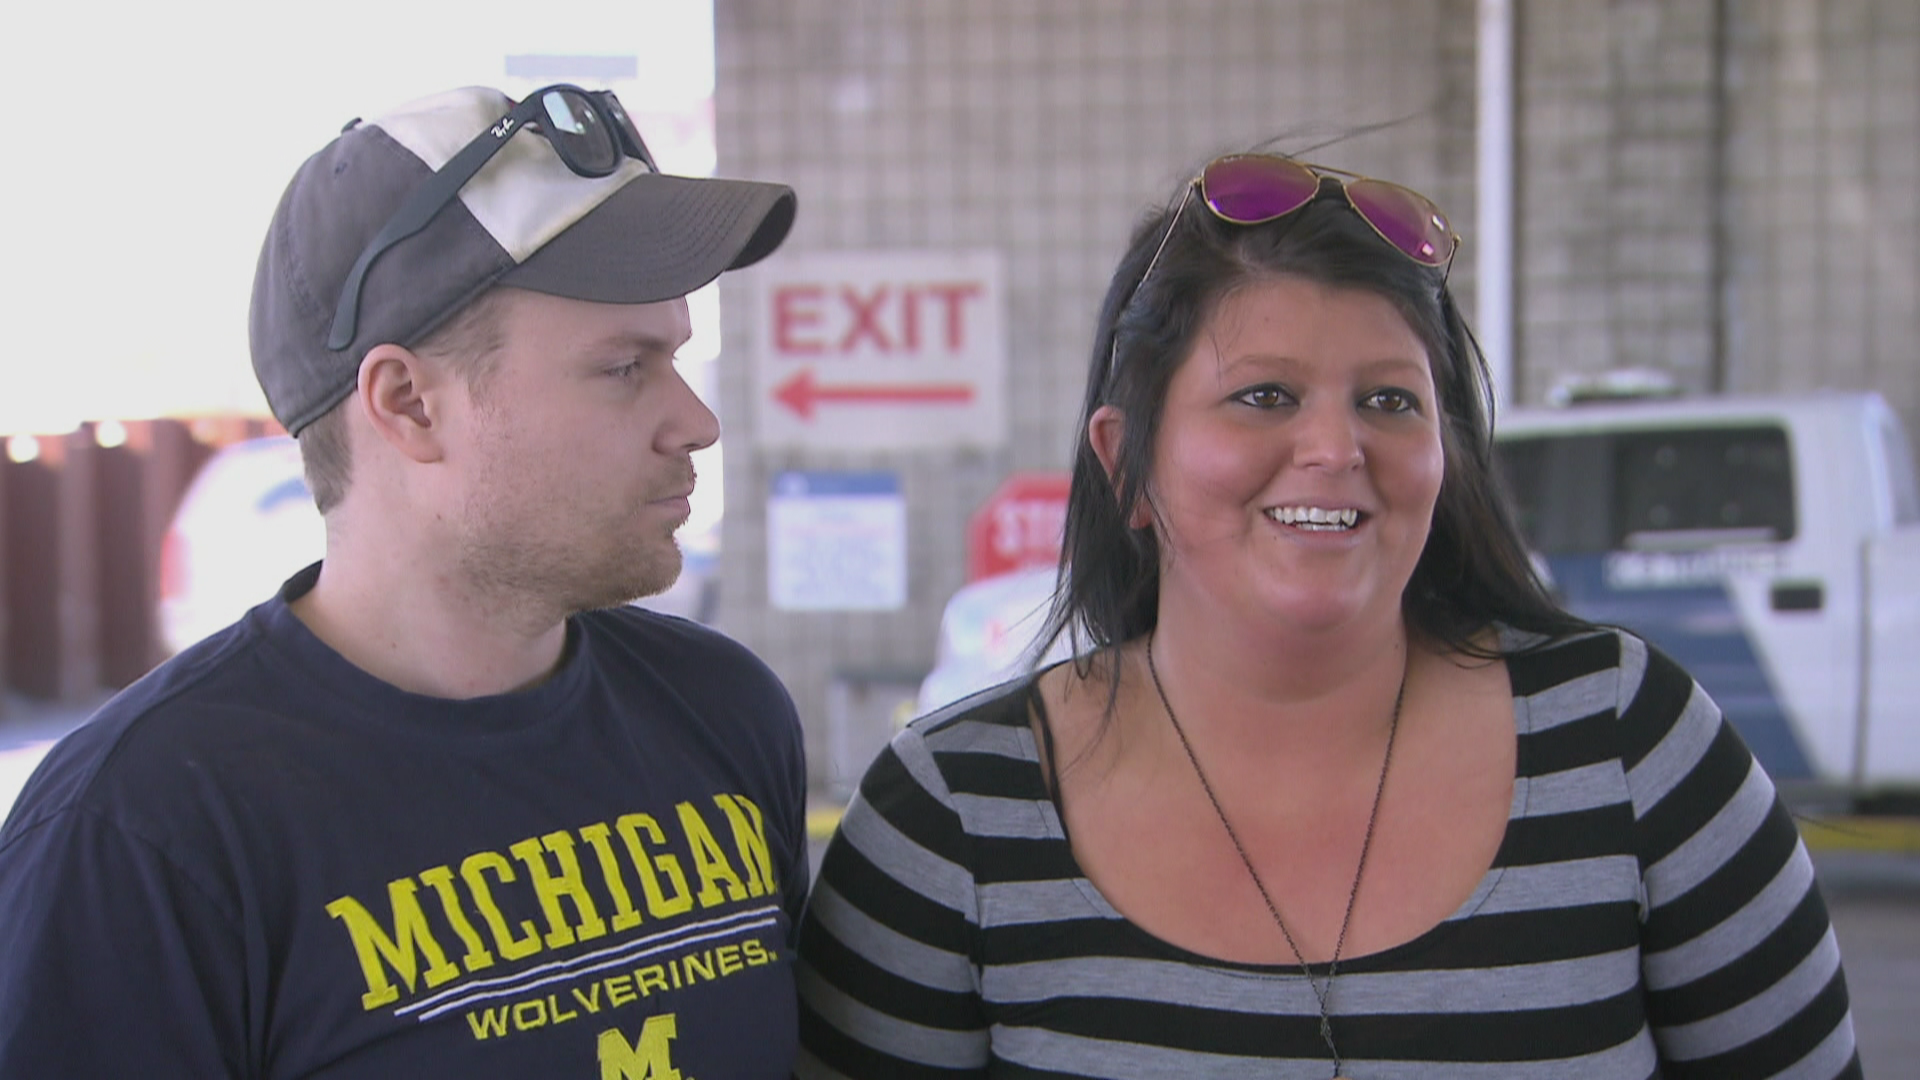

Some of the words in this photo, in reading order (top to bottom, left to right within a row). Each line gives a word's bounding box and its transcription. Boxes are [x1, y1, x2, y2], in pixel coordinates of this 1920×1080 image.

[771, 282, 982, 355] EXIT
[325, 793, 777, 1010] MICHIGAN
[466, 939, 768, 1040] WOLVERINES
[598, 1013, 682, 1080] M
